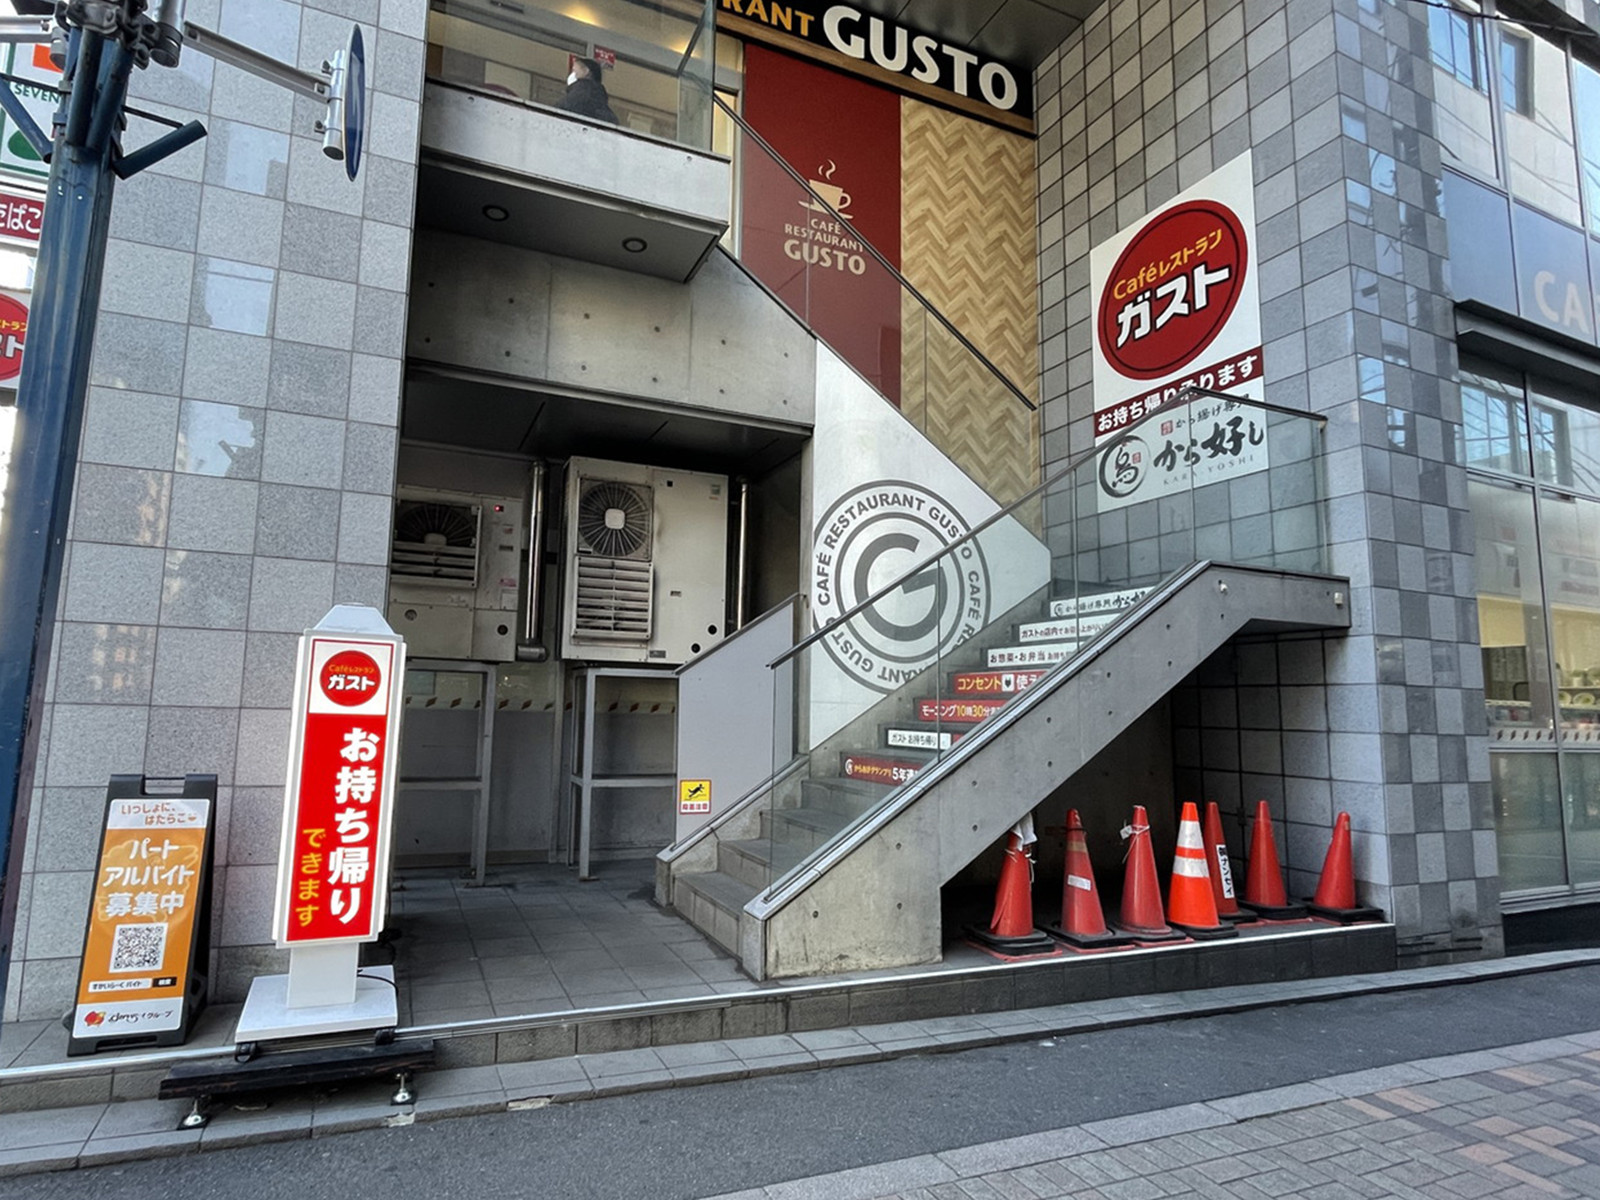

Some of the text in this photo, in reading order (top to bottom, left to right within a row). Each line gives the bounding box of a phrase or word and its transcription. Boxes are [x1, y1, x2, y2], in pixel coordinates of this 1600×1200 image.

[823, 5, 1018, 110] GUSTO
[14, 84, 60, 104] SEVEN
[784, 223, 864, 252] RESTAURANT
[811, 219, 841, 235] CAFÉ
[784, 239, 866, 275] GUSTO
[1113, 228, 1222, 300] Caféレストラン
[1116, 264, 1230, 348] ガスト
[1534, 270, 1600, 335] CA
[0, 320, 27, 332] トラン
[0, 334, 25, 358] ト
[823, 493, 926, 550] RESTAURANT
[816, 552, 832, 606] CAFÉ
[968, 570, 982, 620] CAFÉ
[327, 674, 376, 692] ガスト
[958, 674, 1041, 690] コンセント 使え
[892, 767, 918, 781] 5年連
[327, 727, 380, 925] お持ち帰り
[129, 838, 180, 860] パート
[103, 865, 195, 887] アルバイト
[296, 828, 326, 927] できます
[105, 890, 185, 917] 募集中
